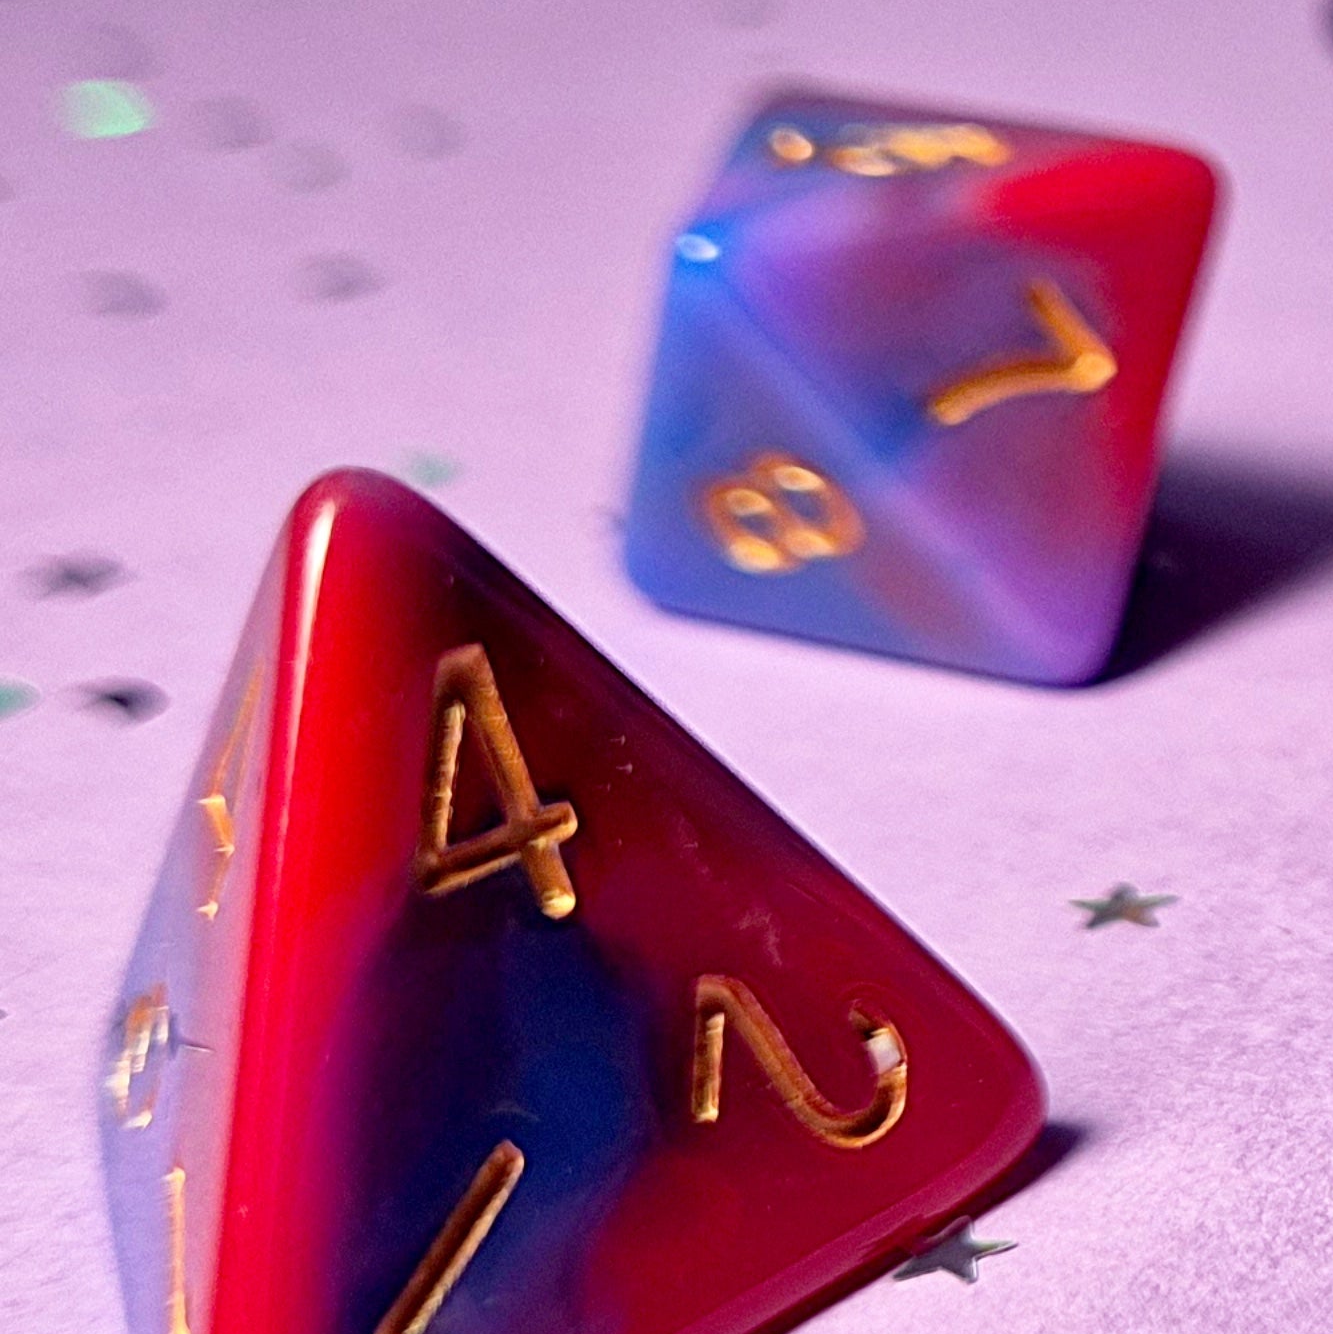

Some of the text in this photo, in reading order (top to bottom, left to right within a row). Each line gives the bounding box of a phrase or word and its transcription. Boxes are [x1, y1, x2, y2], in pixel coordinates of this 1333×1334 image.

[925, 279, 1118, 425] 7
[708, 455, 866, 573] 8
[413, 644, 577, 919] 4
[692, 976, 906, 1147] 2
